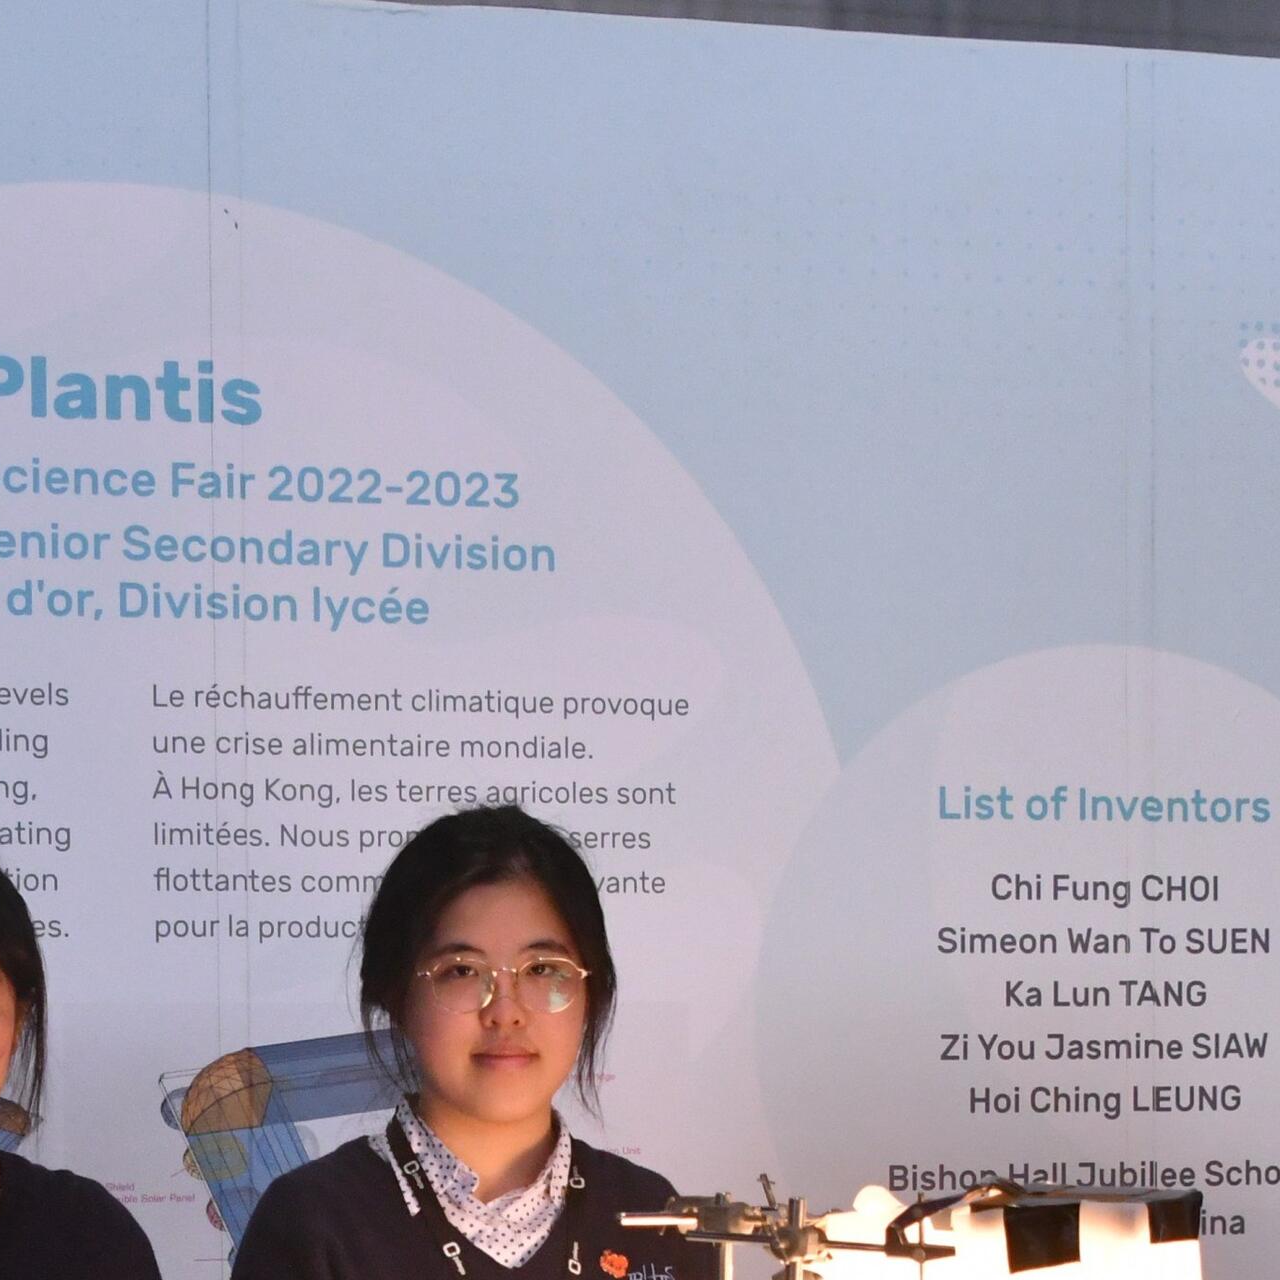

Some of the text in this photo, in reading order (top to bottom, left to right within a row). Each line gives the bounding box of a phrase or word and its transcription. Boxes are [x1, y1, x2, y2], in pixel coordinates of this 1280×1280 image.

[172, 462, 255, 500] Fair
[268, 466, 519, 508] 2022-2023
[123, 525, 368, 576] Secondary
[383, 533, 555, 572] Division
[7, 580, 102, 620] d'or,
[120, 582, 297, 621] Division
[313, 586, 429, 632] lycée
[153, 684, 688, 721] Le réchauffement climatique provoque
[153, 732, 592, 759] une crise alimentaire mondiale.
[153, 771, 676, 808] À Hong Kong, les terres agricoles sont
[940, 786, 1270, 823] List of Inventors
[155, 822, 269, 846] limitées.
[281, 824, 349, 847] Nous
[154, 867, 291, 892] flottantes
[992, 874, 1218, 908] Chi Fung CHOI
[156, 920, 219, 943] pour
[229, 914, 248, 937] la
[938, 927, 1269, 954] Simeon Wan To SUEN
[1006, 980, 1206, 1007] Ka Lun TANG
[941, 1033, 1267, 1060] Zi You Jasmine SIAW
[970, 1085, 1240, 1120] Hoi Ching LEUNG
[1009, 1162, 1066, 1186] Hall
